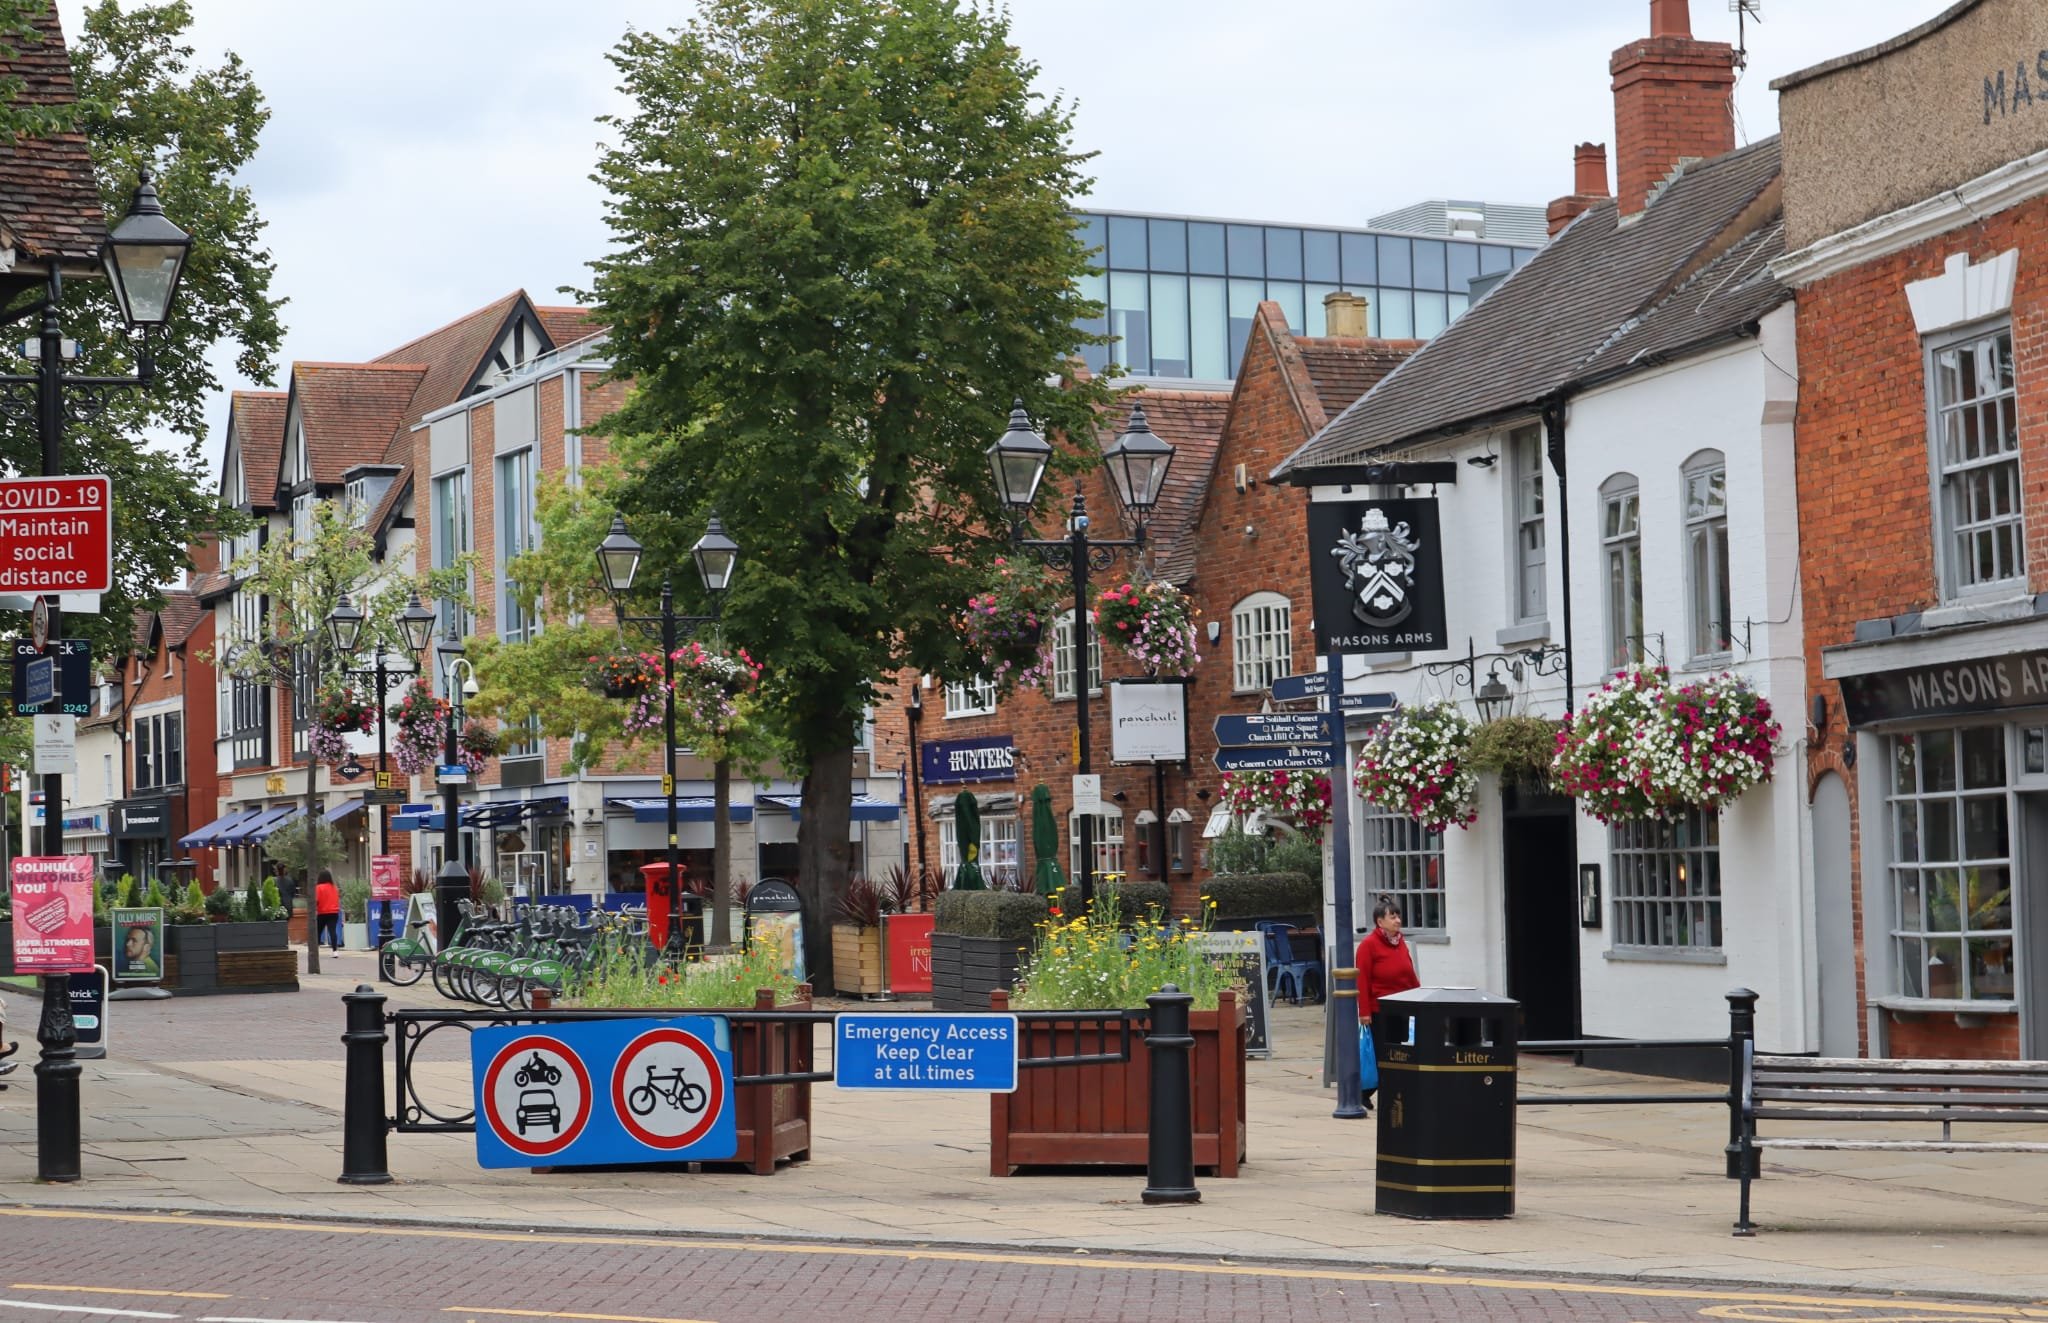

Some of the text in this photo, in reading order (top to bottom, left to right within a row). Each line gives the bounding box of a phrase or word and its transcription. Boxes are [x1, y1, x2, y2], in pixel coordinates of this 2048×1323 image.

[77, 486, 100, 505] 19
[0, 517, 89, 537] Maintain
[13, 541, 75, 561] social
[0, 567, 88, 586] distance
[1330, 632, 1433, 647] MASONS ARMS
[1907, 662, 2012, 710] MASONS
[63, 703, 88, 713] 3242
[1271, 724, 1318, 733] Library Square
[1248, 734, 1272, 742] Church
[1273, 733, 1288, 741] Hill
[1303, 732, 1319, 740] Park
[948, 746, 1014, 772] HUNTERS
[1302, 749, 1322, 758] Priory
[1225, 758, 1324, 770] Age Concern CAB Carers CVS
[378, 774, 389, 786] H
[15, 862, 76, 873] SOLIHULL
[15, 872, 85, 883] WELCOMES
[15, 883, 47, 894] YOU!
[117, 912, 157, 923] OLLY MURS
[44, 939, 90, 947] STRONGER
[15, 947, 57, 955] SOLIHULL
[910, 945, 932, 956] irre
[912, 956, 932, 973] IN
[845, 1023, 1008, 1042] Emergency Access
[876, 1044, 975, 1062] Keep Clear
[1389, 1049, 1408, 1061] Litter
[1455, 1051, 1490, 1064] Litter
[874, 1065, 975, 1080] at all times
